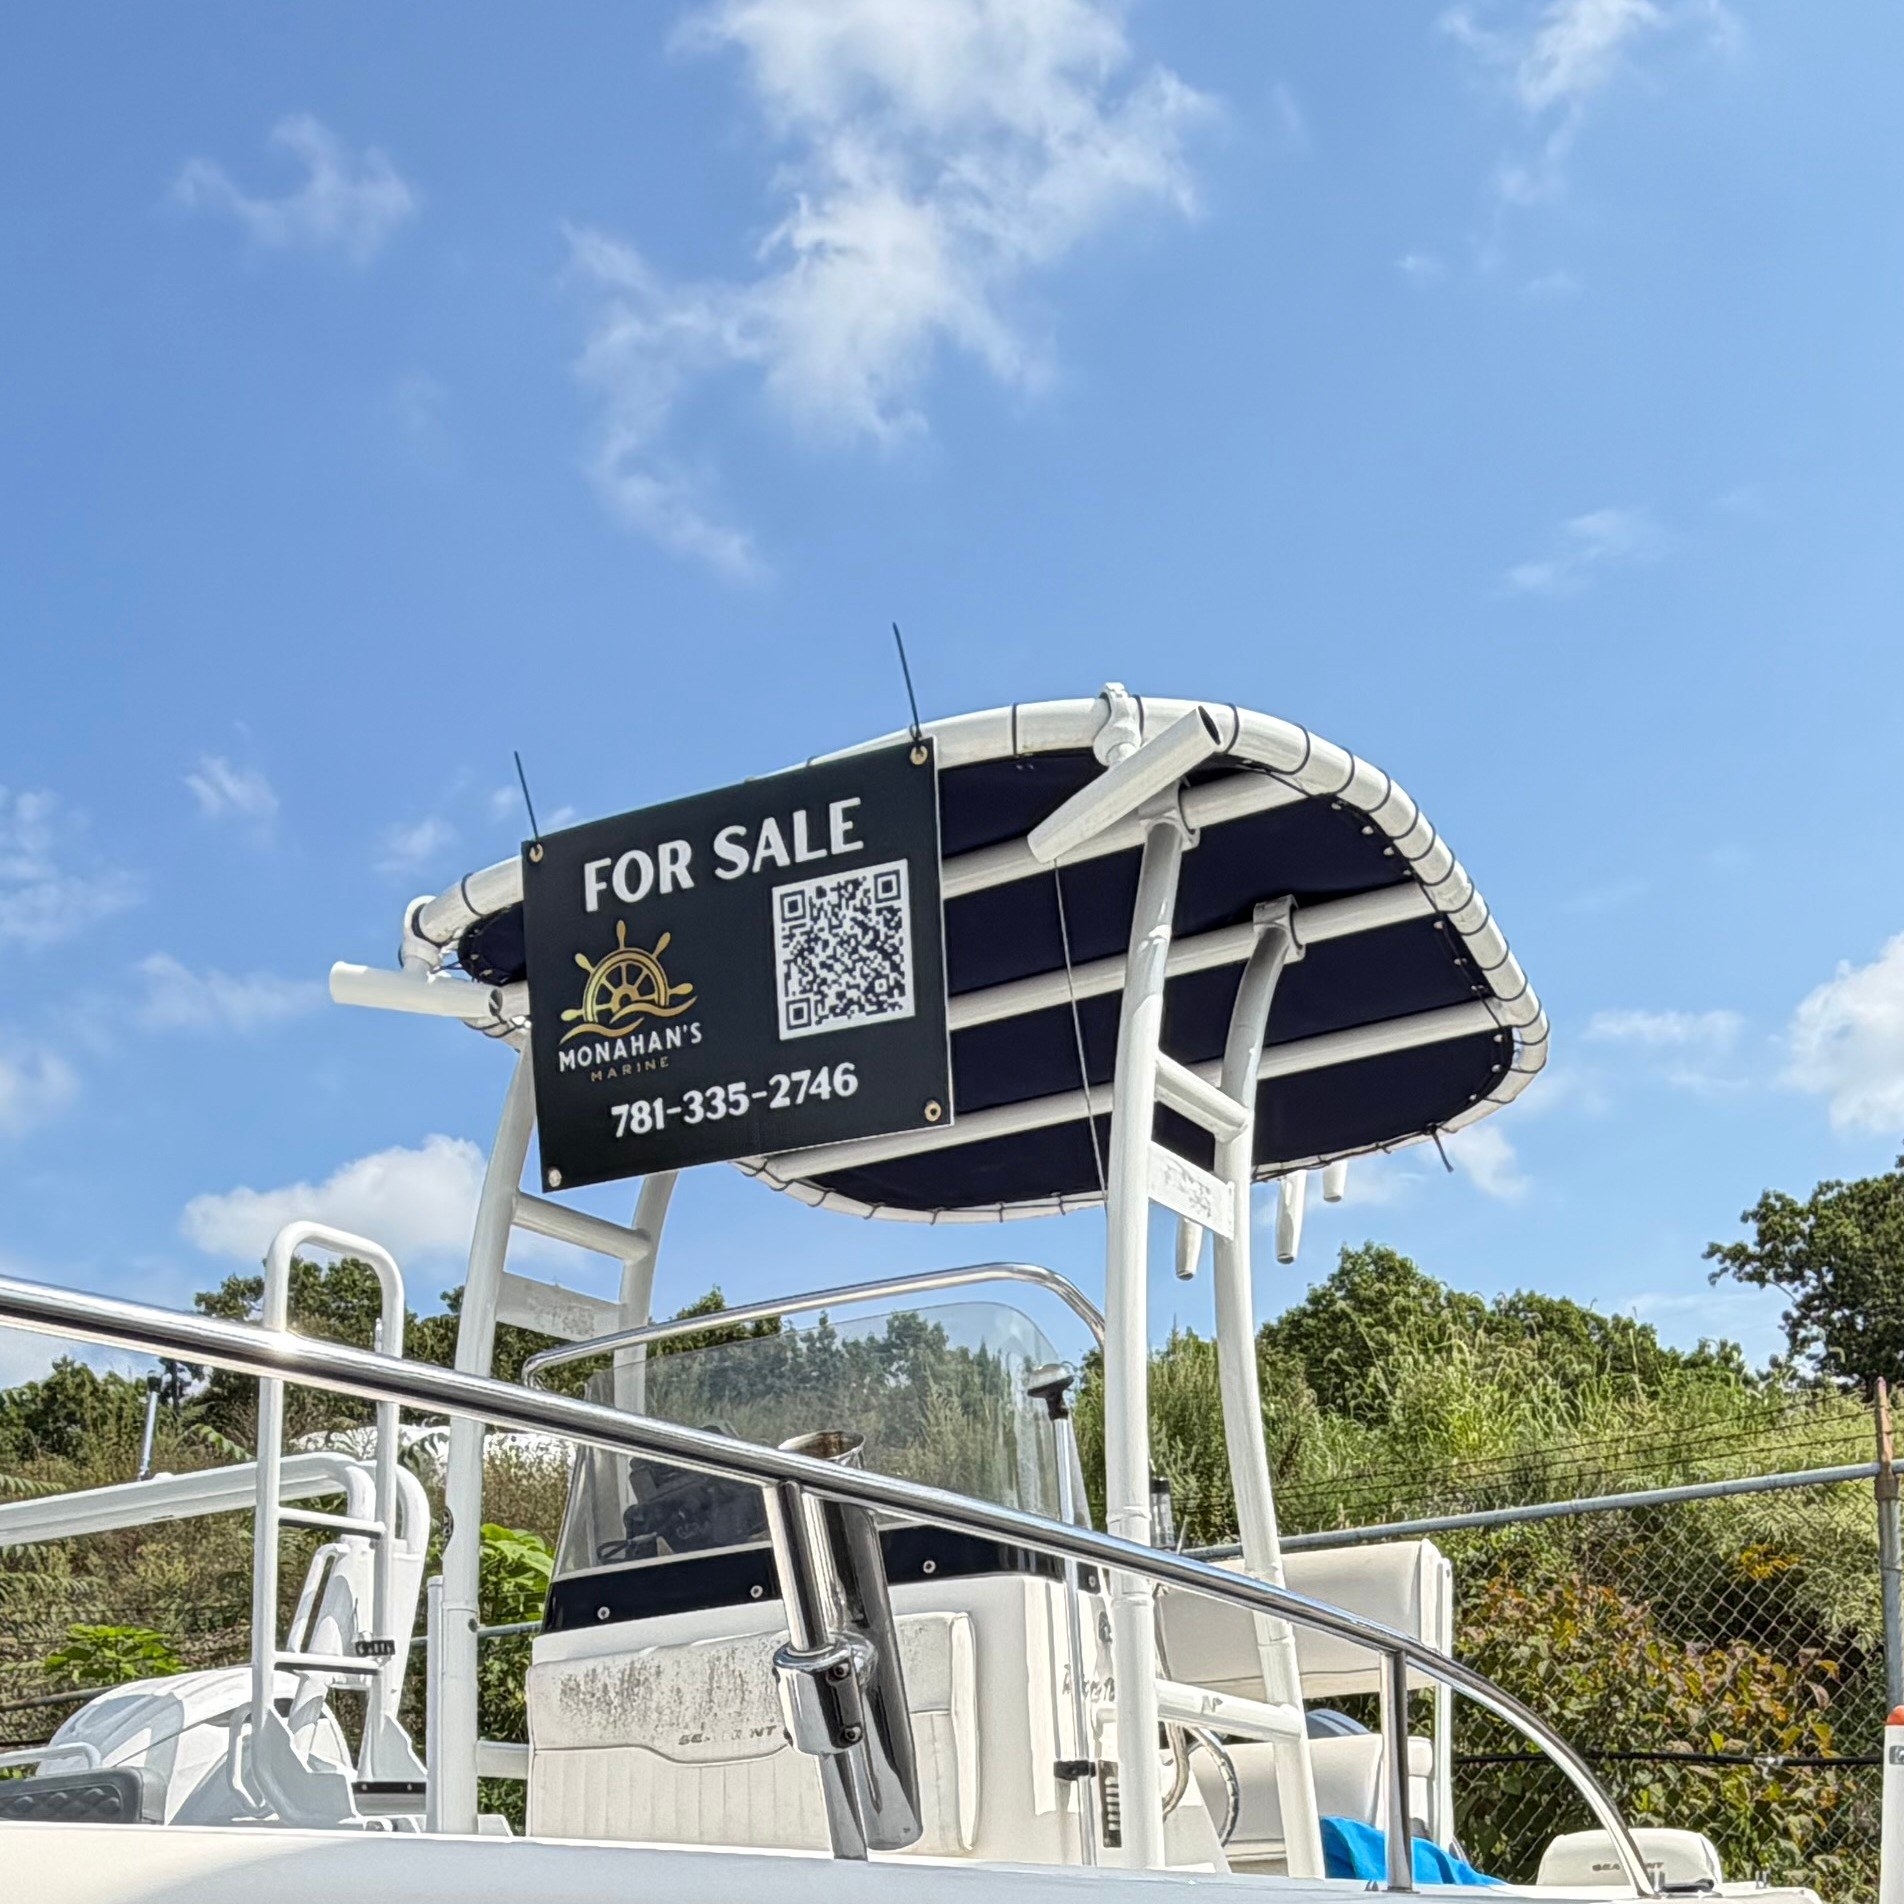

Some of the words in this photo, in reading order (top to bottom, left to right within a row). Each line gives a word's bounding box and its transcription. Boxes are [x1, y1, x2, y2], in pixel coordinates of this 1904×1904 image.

[584, 839, 695, 912] FOR
[713, 797, 864, 881] SALE
[558, 1021, 703, 1074] MONAHAN'S
[590, 1056, 670, 1082] MARINE
[610, 1061, 859, 1138] 781-335-2746
